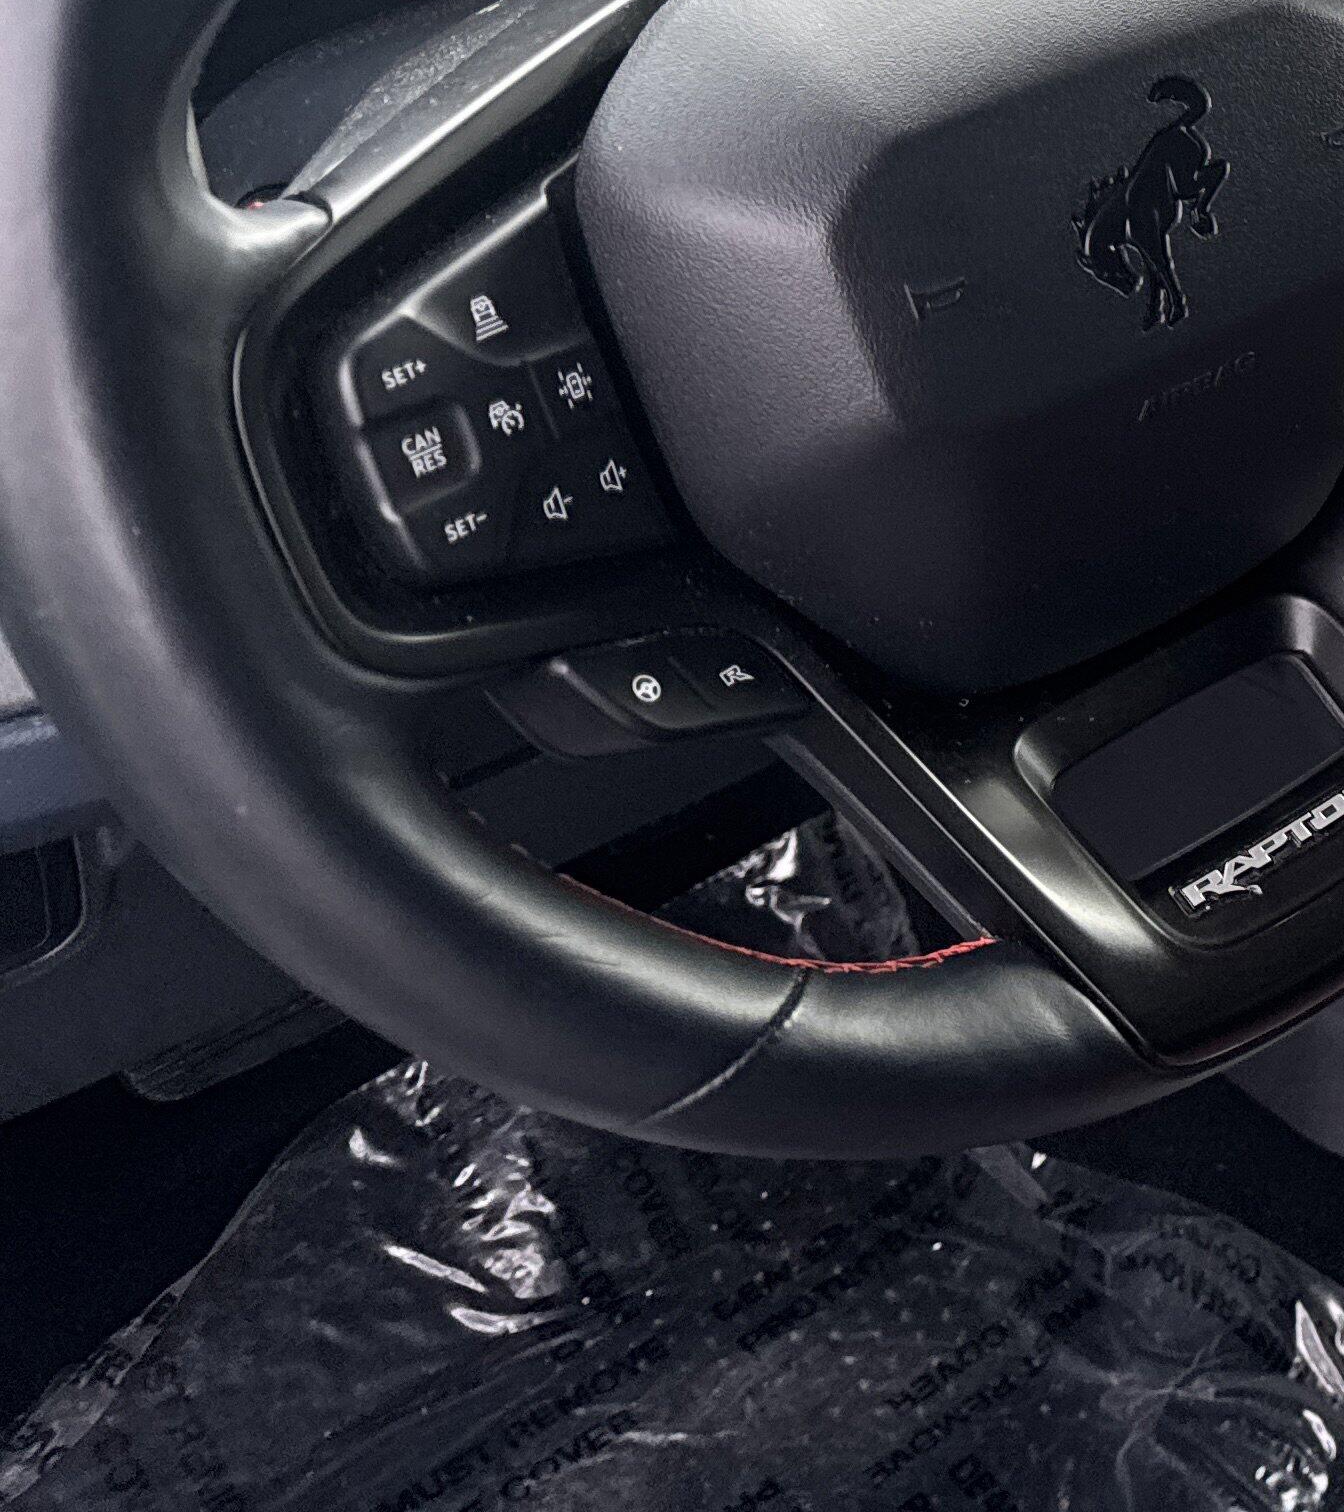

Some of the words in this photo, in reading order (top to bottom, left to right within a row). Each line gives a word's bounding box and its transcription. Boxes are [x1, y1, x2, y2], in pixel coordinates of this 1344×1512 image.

[381, 359, 427, 391] SET+
[401, 426, 442, 458] CAN
[411, 449, 448, 479] RES
